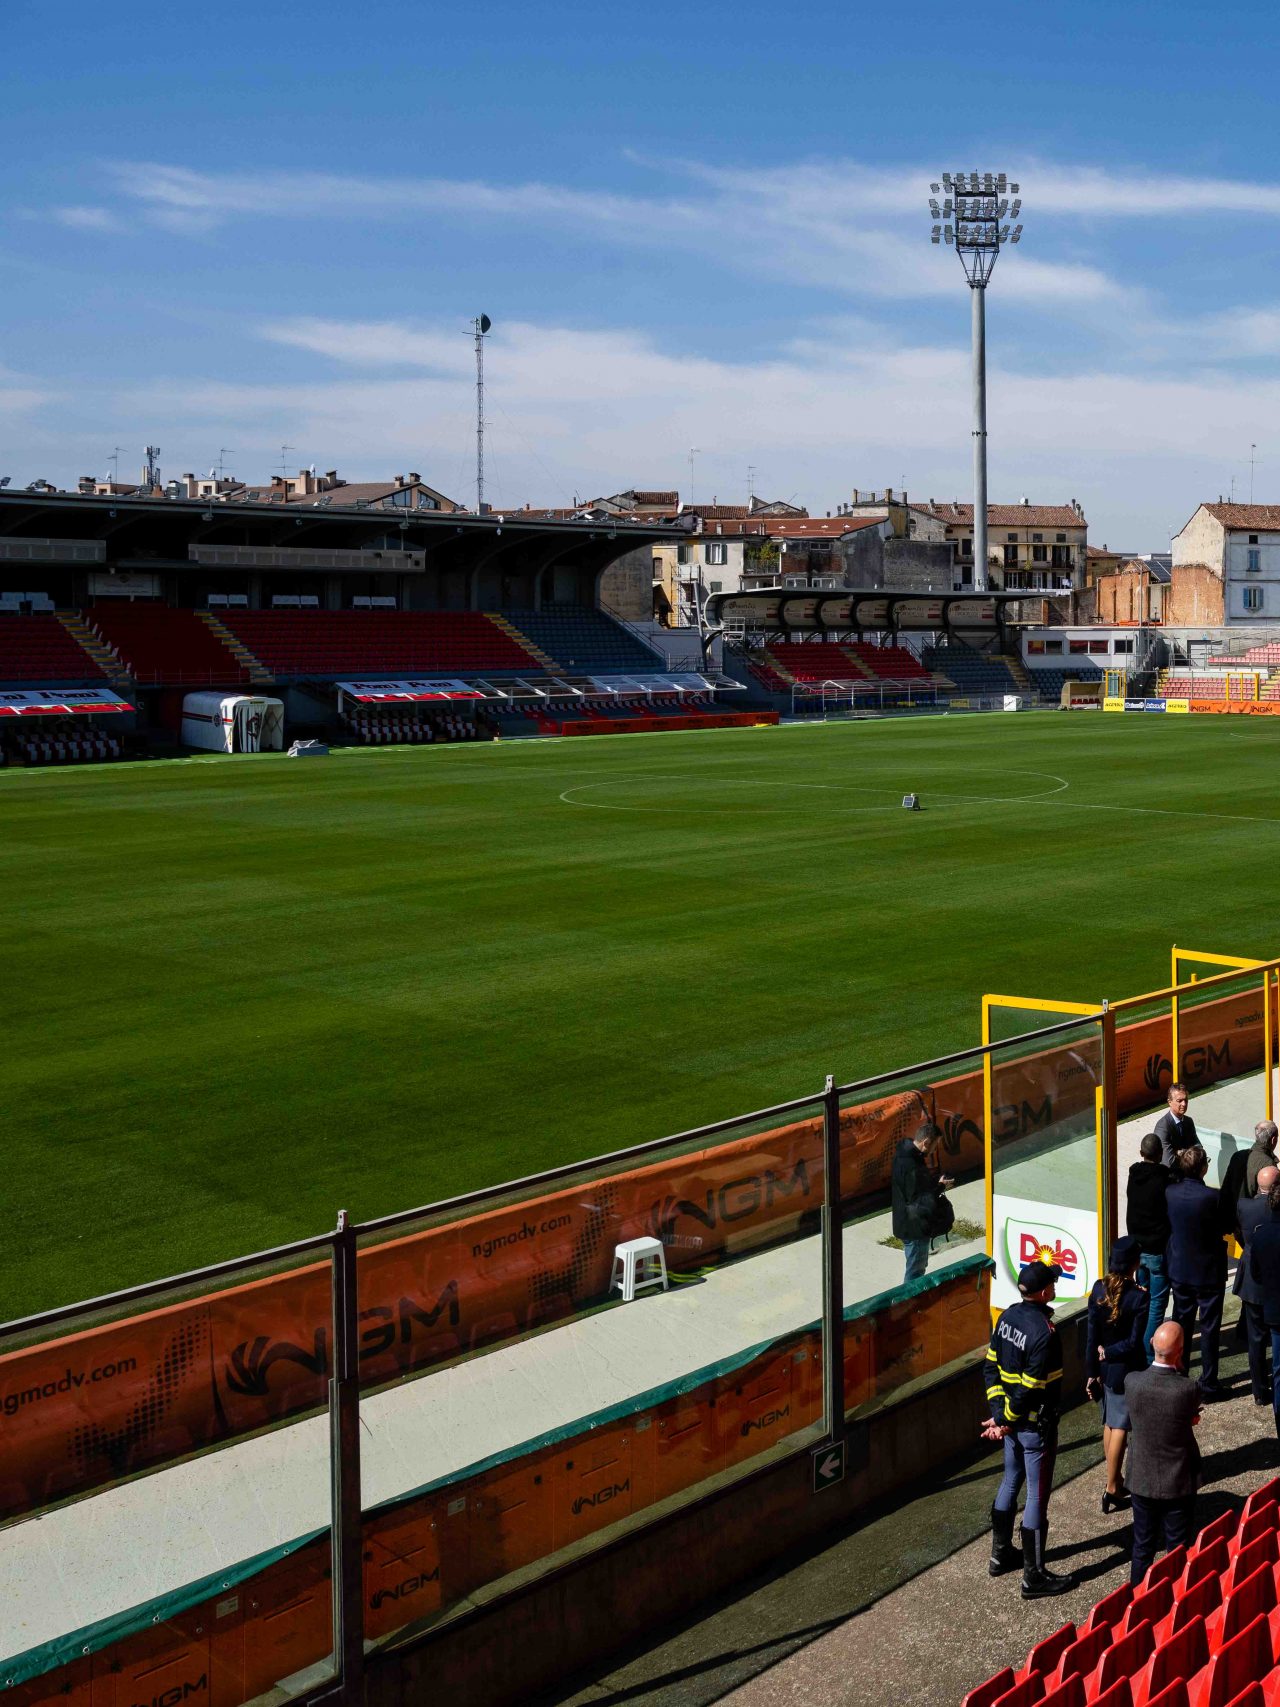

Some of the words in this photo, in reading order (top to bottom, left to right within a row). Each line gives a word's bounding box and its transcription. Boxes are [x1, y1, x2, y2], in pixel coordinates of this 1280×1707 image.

[1189, 705, 1211, 713] NGM
[645, 1158, 811, 1244] NGM
[472, 1213, 571, 1258] ngmadv.com
[1019, 1232, 1078, 1273] Dole
[997, 1320, 1027, 1351] POLIZIA
[0, 1357, 137, 1416] gmadv.com
[741, 1405, 790, 1436] NGM
[571, 1477, 630, 1515] NGM
[370, 1566, 440, 1610] NGM
